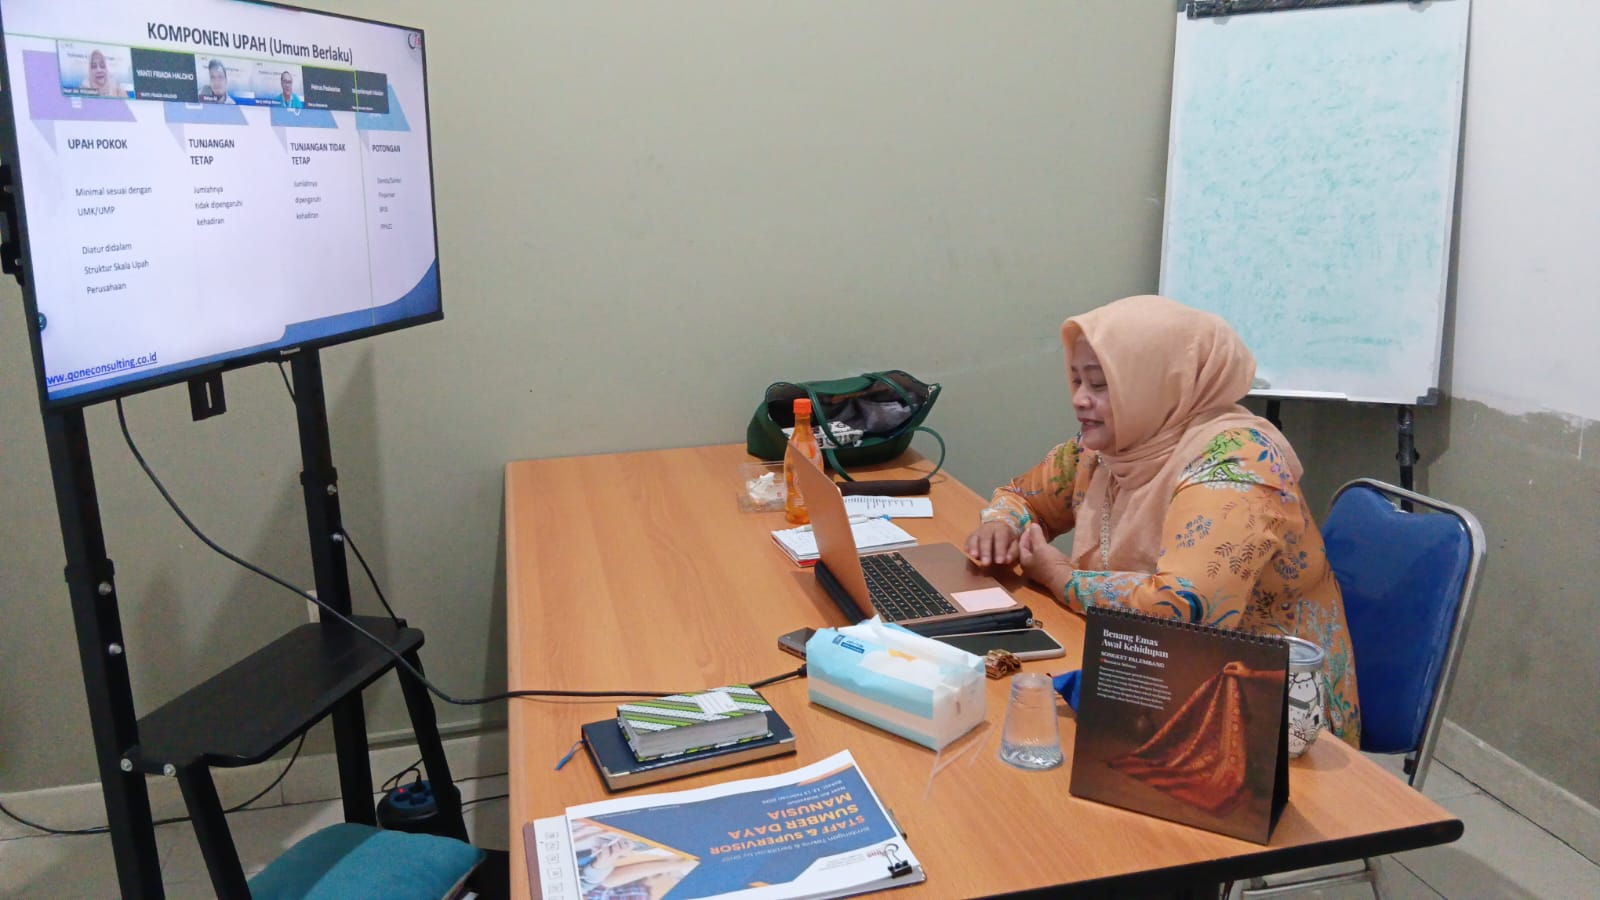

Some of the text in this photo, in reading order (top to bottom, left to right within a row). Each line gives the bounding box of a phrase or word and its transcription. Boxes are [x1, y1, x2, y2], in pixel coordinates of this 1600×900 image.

[147, 22, 353, 66] KOMPONEN UPAH (Umum Berlaku)
[68, 139, 128, 150] UPAH POKOK
[189, 139, 235, 149] TUNJANGAN
[290, 142, 346, 152] TUNJANGAN TIDAK
[372, 144, 401, 153] POTONGAN
[190, 155, 214, 165] TETAP
[292, 156, 311, 165] TETAP
[75, 185, 152, 197] Minimal sesuai dengan
[78, 206, 116, 217] UMK/UMP
[197, 217, 225, 226] kehadiran
[82, 242, 133, 255] Diatur didalam
[84, 260, 150, 275] Struktur Skala Upah
[86, 282, 127, 295] Perusahaan
[46, 352, 157, 384] ww.qoneconsulting.co.id
[1103, 629, 1159, 647] Benang Emas
[1101, 639, 1169, 659] Awal Kehidupan
[766, 792, 853, 820] MANUSIA
[727, 804, 859, 840] SUMBER DAYA
[709, 815, 865, 856] STAFF & SUPERVISOR
